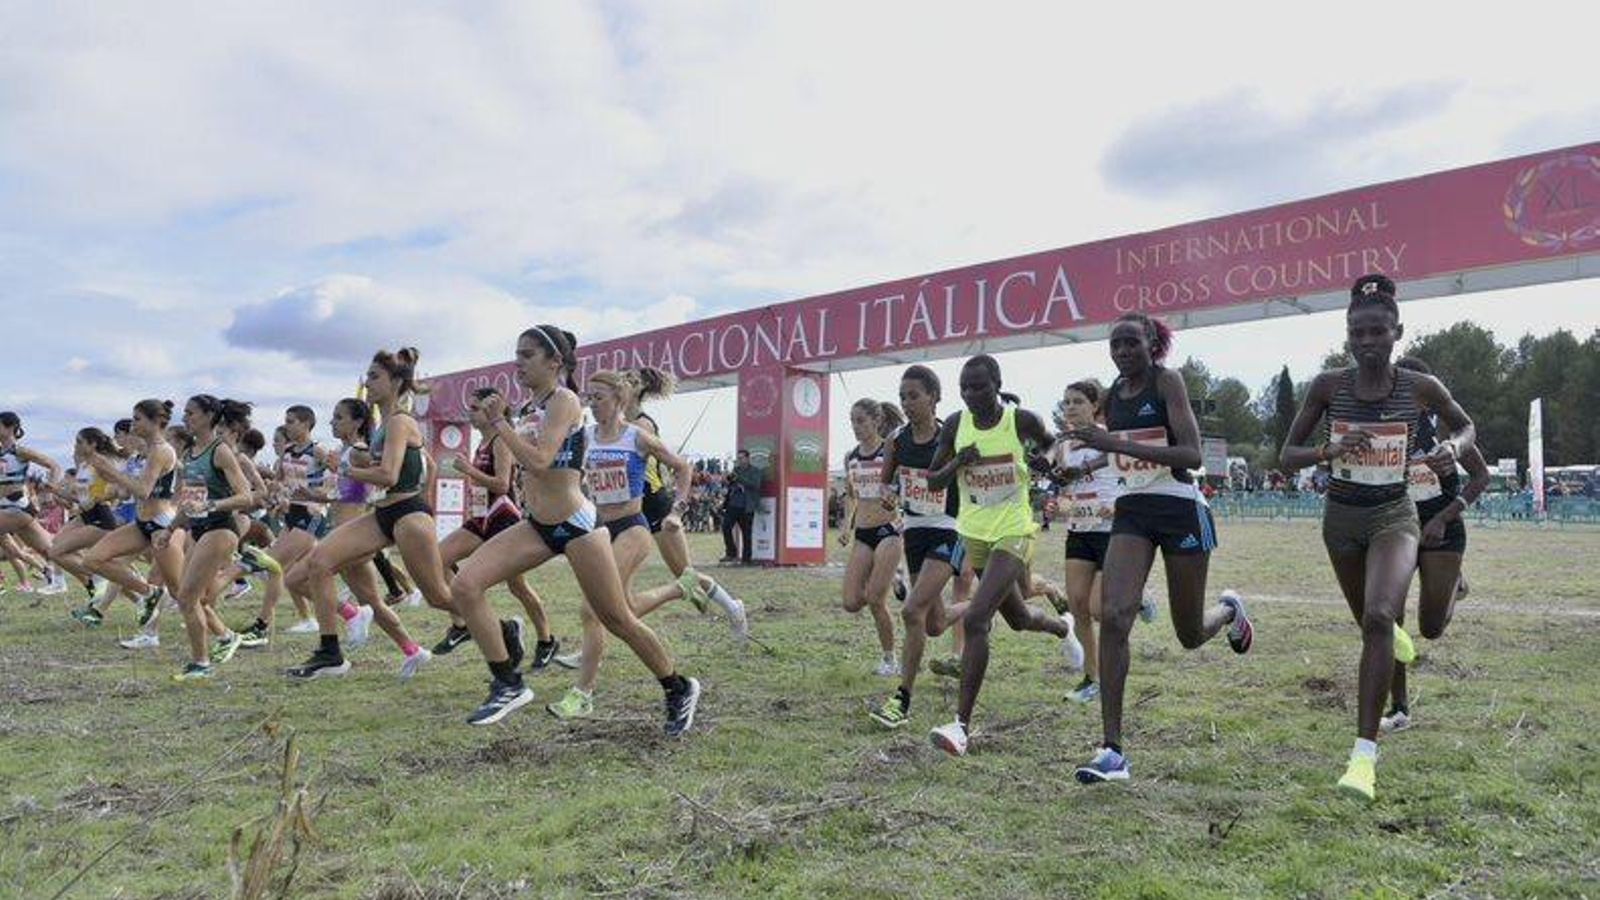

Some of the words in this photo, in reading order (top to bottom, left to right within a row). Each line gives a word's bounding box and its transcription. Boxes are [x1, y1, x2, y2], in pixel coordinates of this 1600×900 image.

[1116, 203, 1389, 274] INTERNATIONAL
[1114, 275, 1210, 312] CROSS
[1225, 244, 1407, 296] COUNTRY
[462, 371, 535, 411] COS
[577, 308, 838, 393] TENACIONAL
[857, 263, 1085, 351] ITÁLICA
